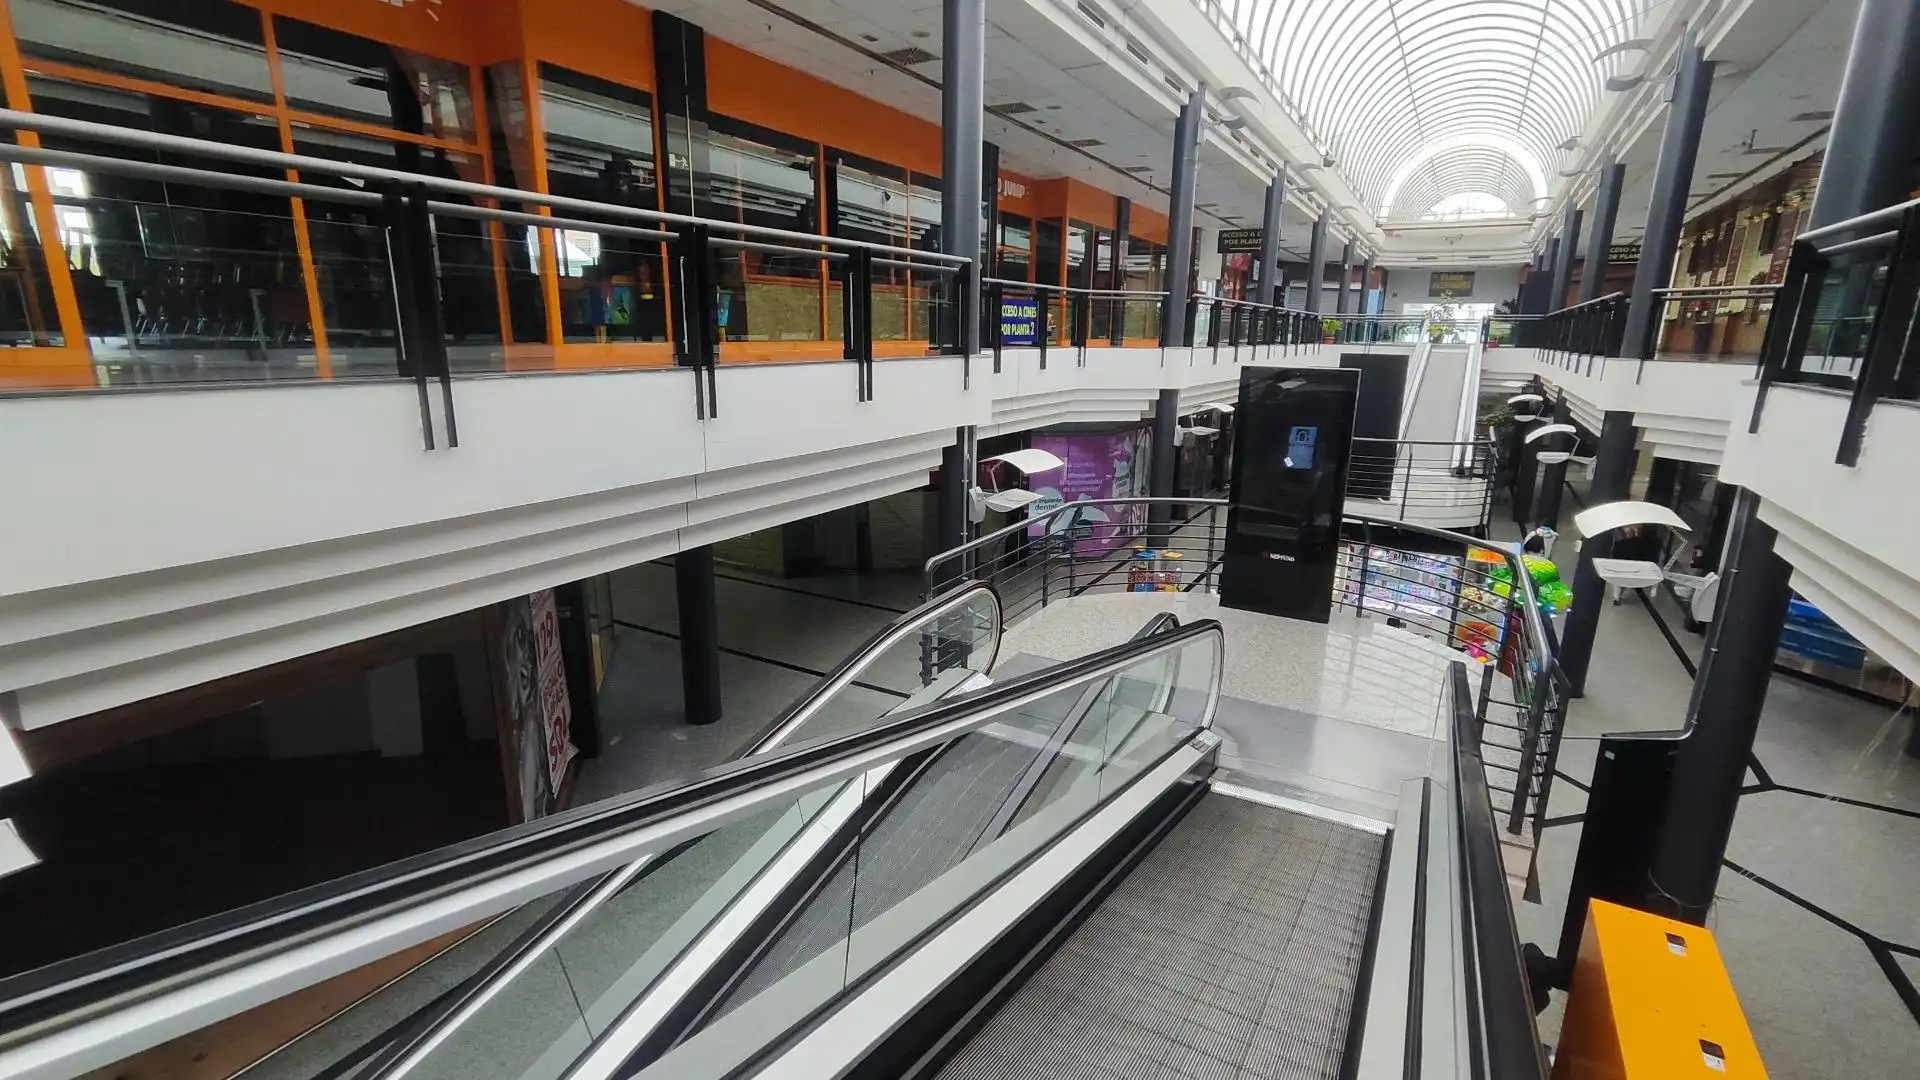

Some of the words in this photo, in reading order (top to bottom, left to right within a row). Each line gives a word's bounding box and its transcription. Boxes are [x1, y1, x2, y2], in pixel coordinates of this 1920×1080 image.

[1004, 180, 1026, 198] JUMP
[1001, 304, 1018, 317] CCESO
[1018, 306, 1023, 318] A
[1011, 323, 1030, 336] PLANTA
[1030, 321, 1035, 336] 2
